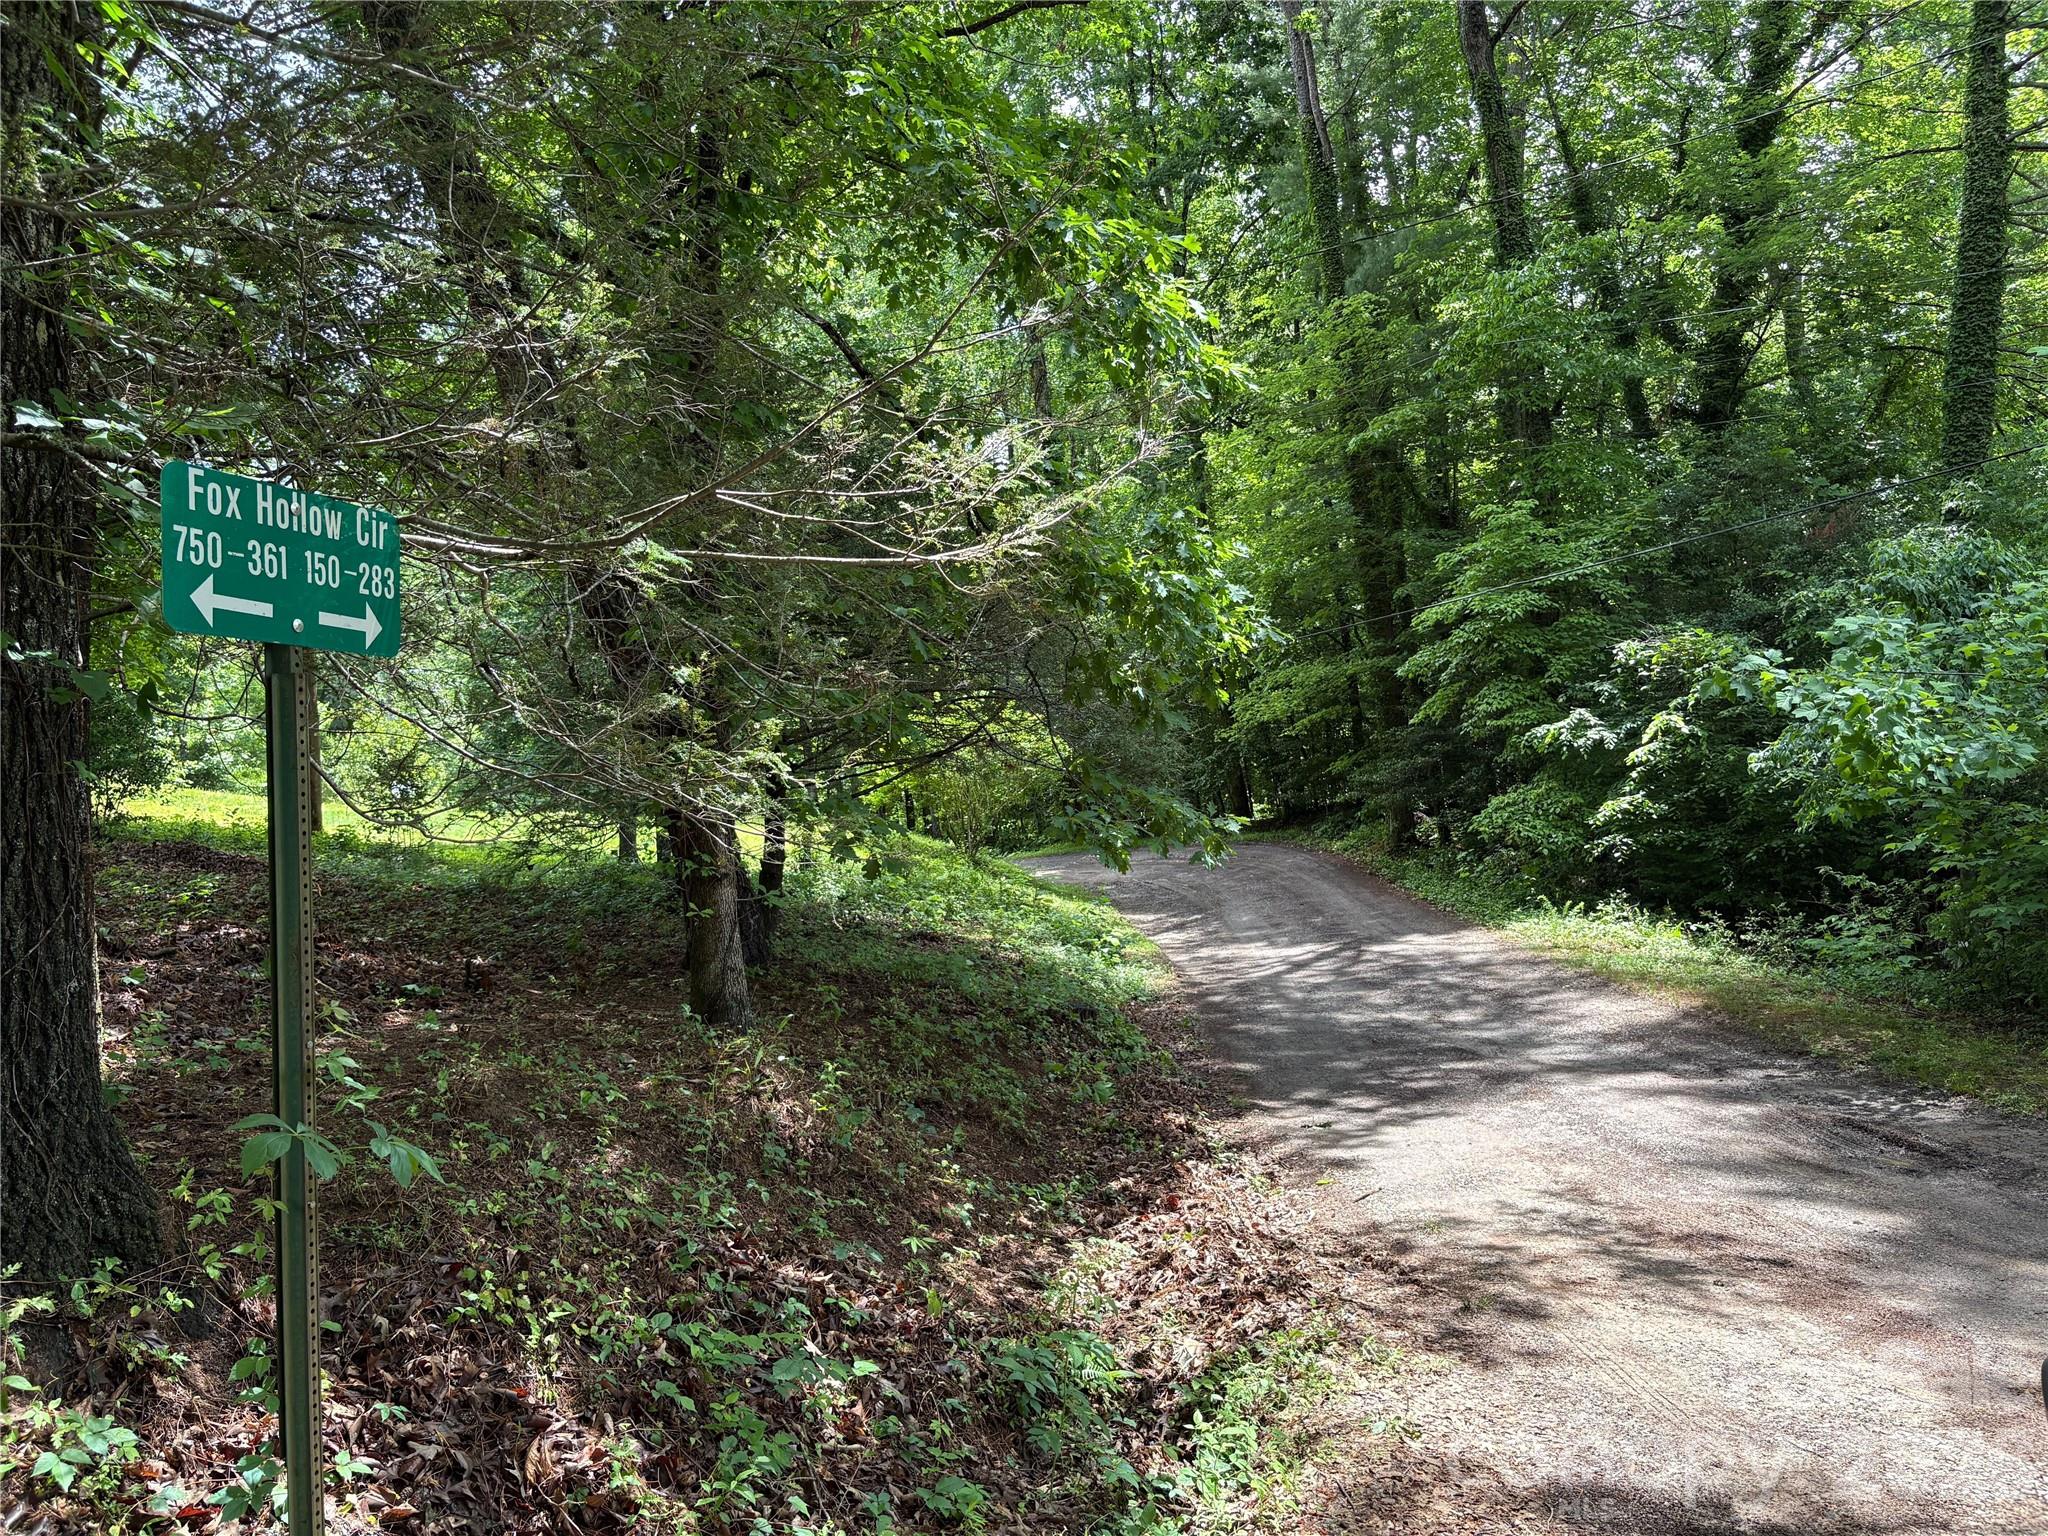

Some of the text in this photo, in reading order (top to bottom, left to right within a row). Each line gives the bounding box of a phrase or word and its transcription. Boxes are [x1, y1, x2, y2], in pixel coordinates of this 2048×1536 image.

[188, 467, 388, 550] Fox Hollow Cir
